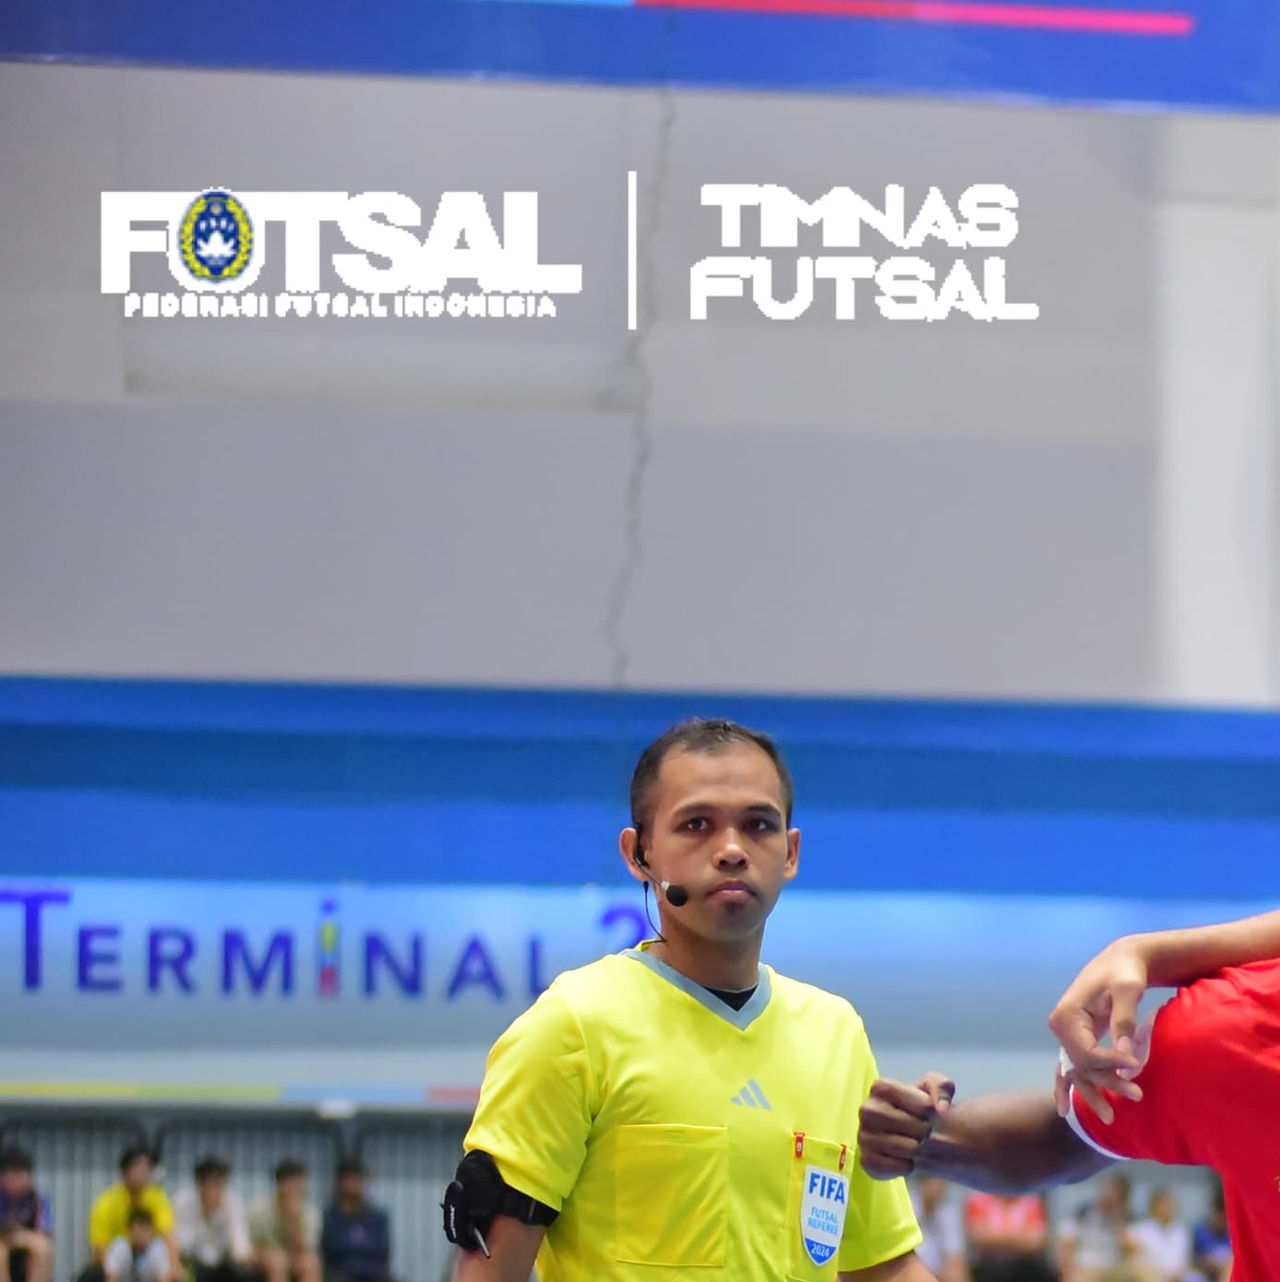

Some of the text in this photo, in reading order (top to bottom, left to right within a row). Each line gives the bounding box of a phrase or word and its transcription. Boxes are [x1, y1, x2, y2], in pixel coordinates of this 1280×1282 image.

[808, 1172, 846, 1205] FIFA
[811, 1206, 838, 1224] FUTSAL
[808, 1217, 838, 1235] REFEREE
